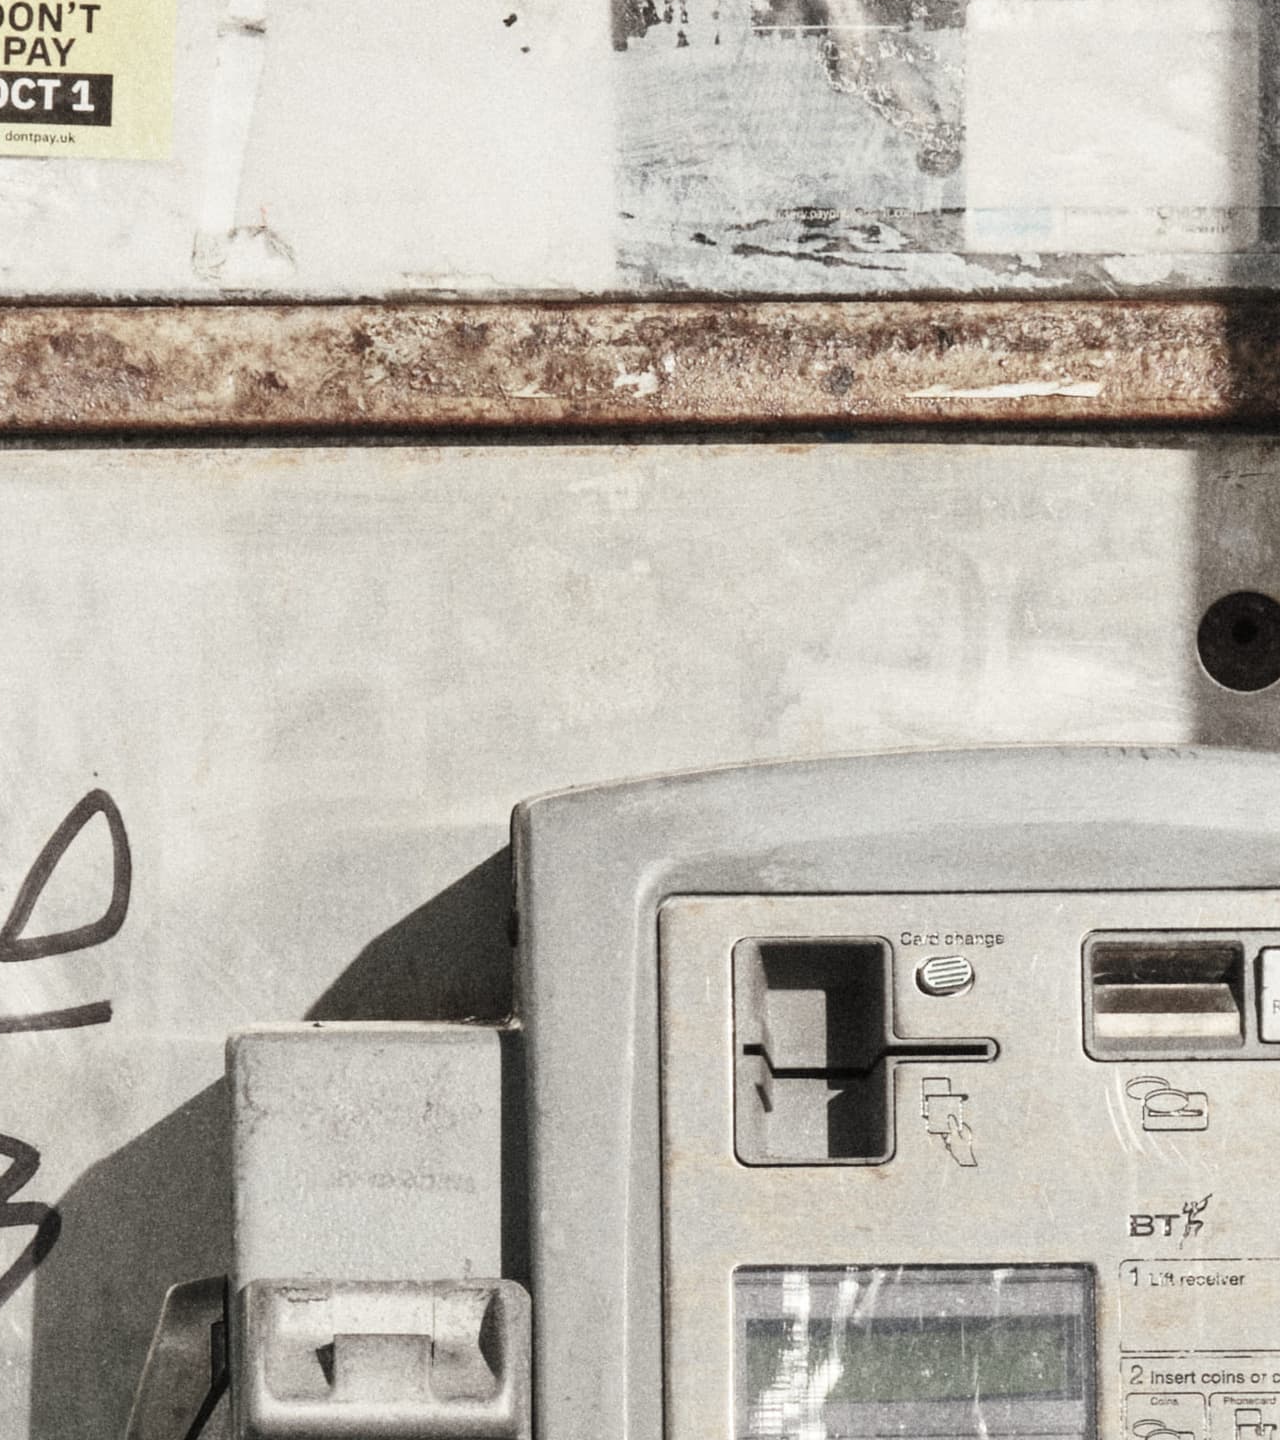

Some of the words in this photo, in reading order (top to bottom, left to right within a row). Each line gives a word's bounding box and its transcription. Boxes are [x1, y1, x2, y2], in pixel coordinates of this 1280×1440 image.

[3, 36, 76, 67] PAY
[70, 79, 95, 112] 1
[4, 130, 76, 144] dontpay.uk
[900, 931, 939, 946] Card
[944, 931, 1005, 948] change
[1129, 1214, 1181, 1237] BT
[1129, 1267, 1139, 1287] 1
[1179, 1273, 1246, 1287] receiver
[1130, 1364, 1145, 1385] 2
[1150, 1370, 1197, 1385] Insert
[1201, 1370, 1245, 1385] coins
[1250, 1372, 1267, 1385] or
